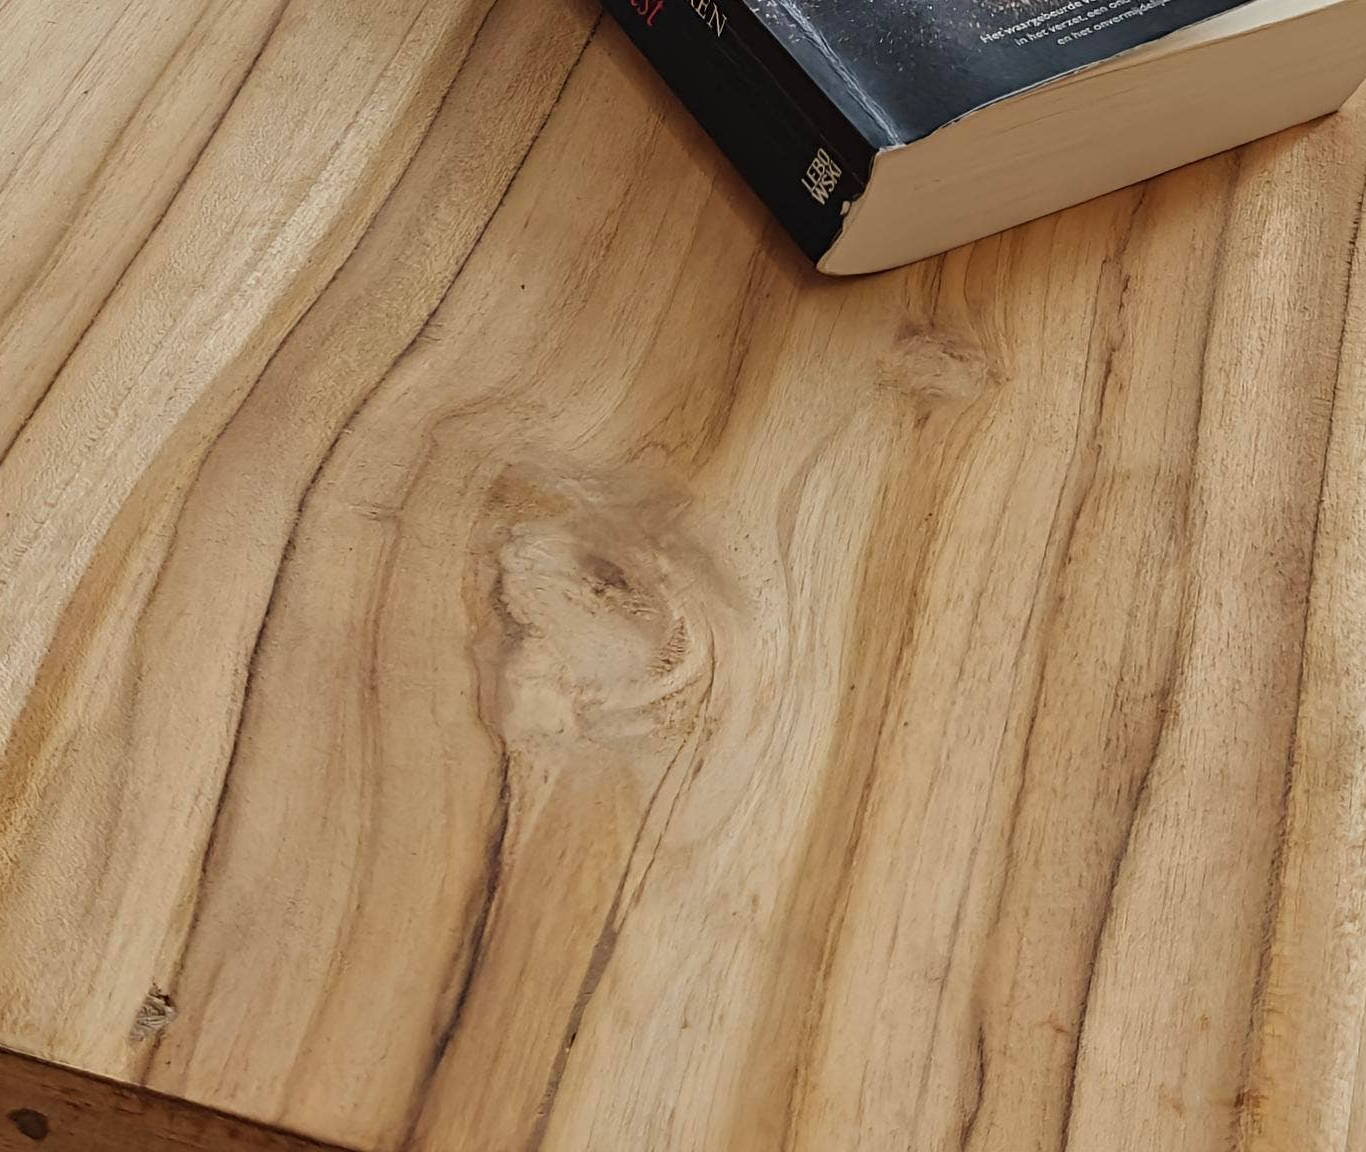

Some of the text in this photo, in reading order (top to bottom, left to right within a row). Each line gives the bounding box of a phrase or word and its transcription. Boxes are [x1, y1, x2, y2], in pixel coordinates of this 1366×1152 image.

[980, 28, 1005, 43] Het
[1005, 1, 1082, 35] waargebeurde
[1026, 28, 1049, 41] het
[1087, 5, 1108, 18] een
[1057, 35, 1073, 46] en
[1071, 26, 1093, 40] het
[801, 148, 830, 193] LEBO
[811, 159, 842, 205] WSKI
